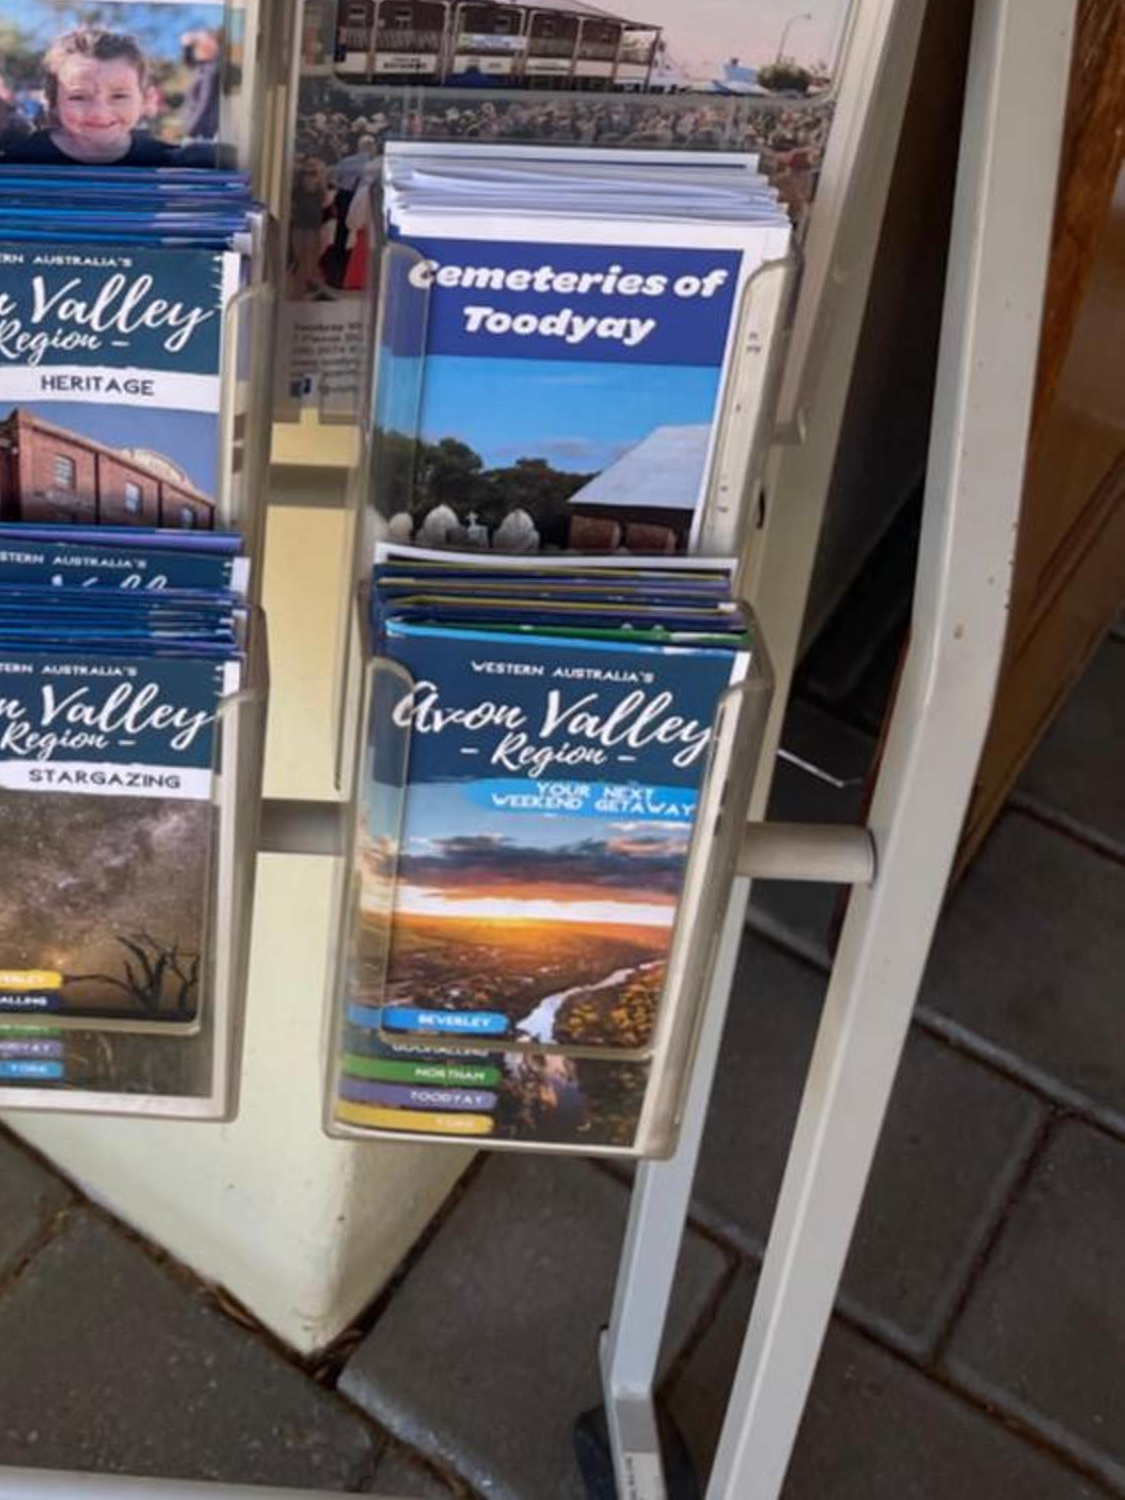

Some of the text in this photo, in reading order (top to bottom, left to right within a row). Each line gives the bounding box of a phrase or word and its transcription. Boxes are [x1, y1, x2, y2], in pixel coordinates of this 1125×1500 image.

[33, 254, 133, 268] AUSTRALIA'S
[408, 260, 729, 298] Cemeteries of
[32, 273, 214, 351] Valley
[463, 306, 656, 346] Toodyay
[40, 375, 155, 397] HERITAGE
[42, 664, 138, 678] AUSTRALIA'S
[471, 660, 654, 684] WESTERN AUSTRALIA'S
[41, 683, 216, 750] Valley
[391, 681, 720, 768] Avon Valley
[0, 722, 106, 762] Region
[491, 732, 607, 778] Region
[28, 768, 181, 790] STARGAZING
[536, 781, 656, 801] YOUR NEXT
[491, 793, 696, 818] WEEKEND GETAWAY
[417, 1013, 491, 1029] BEVERLEY
